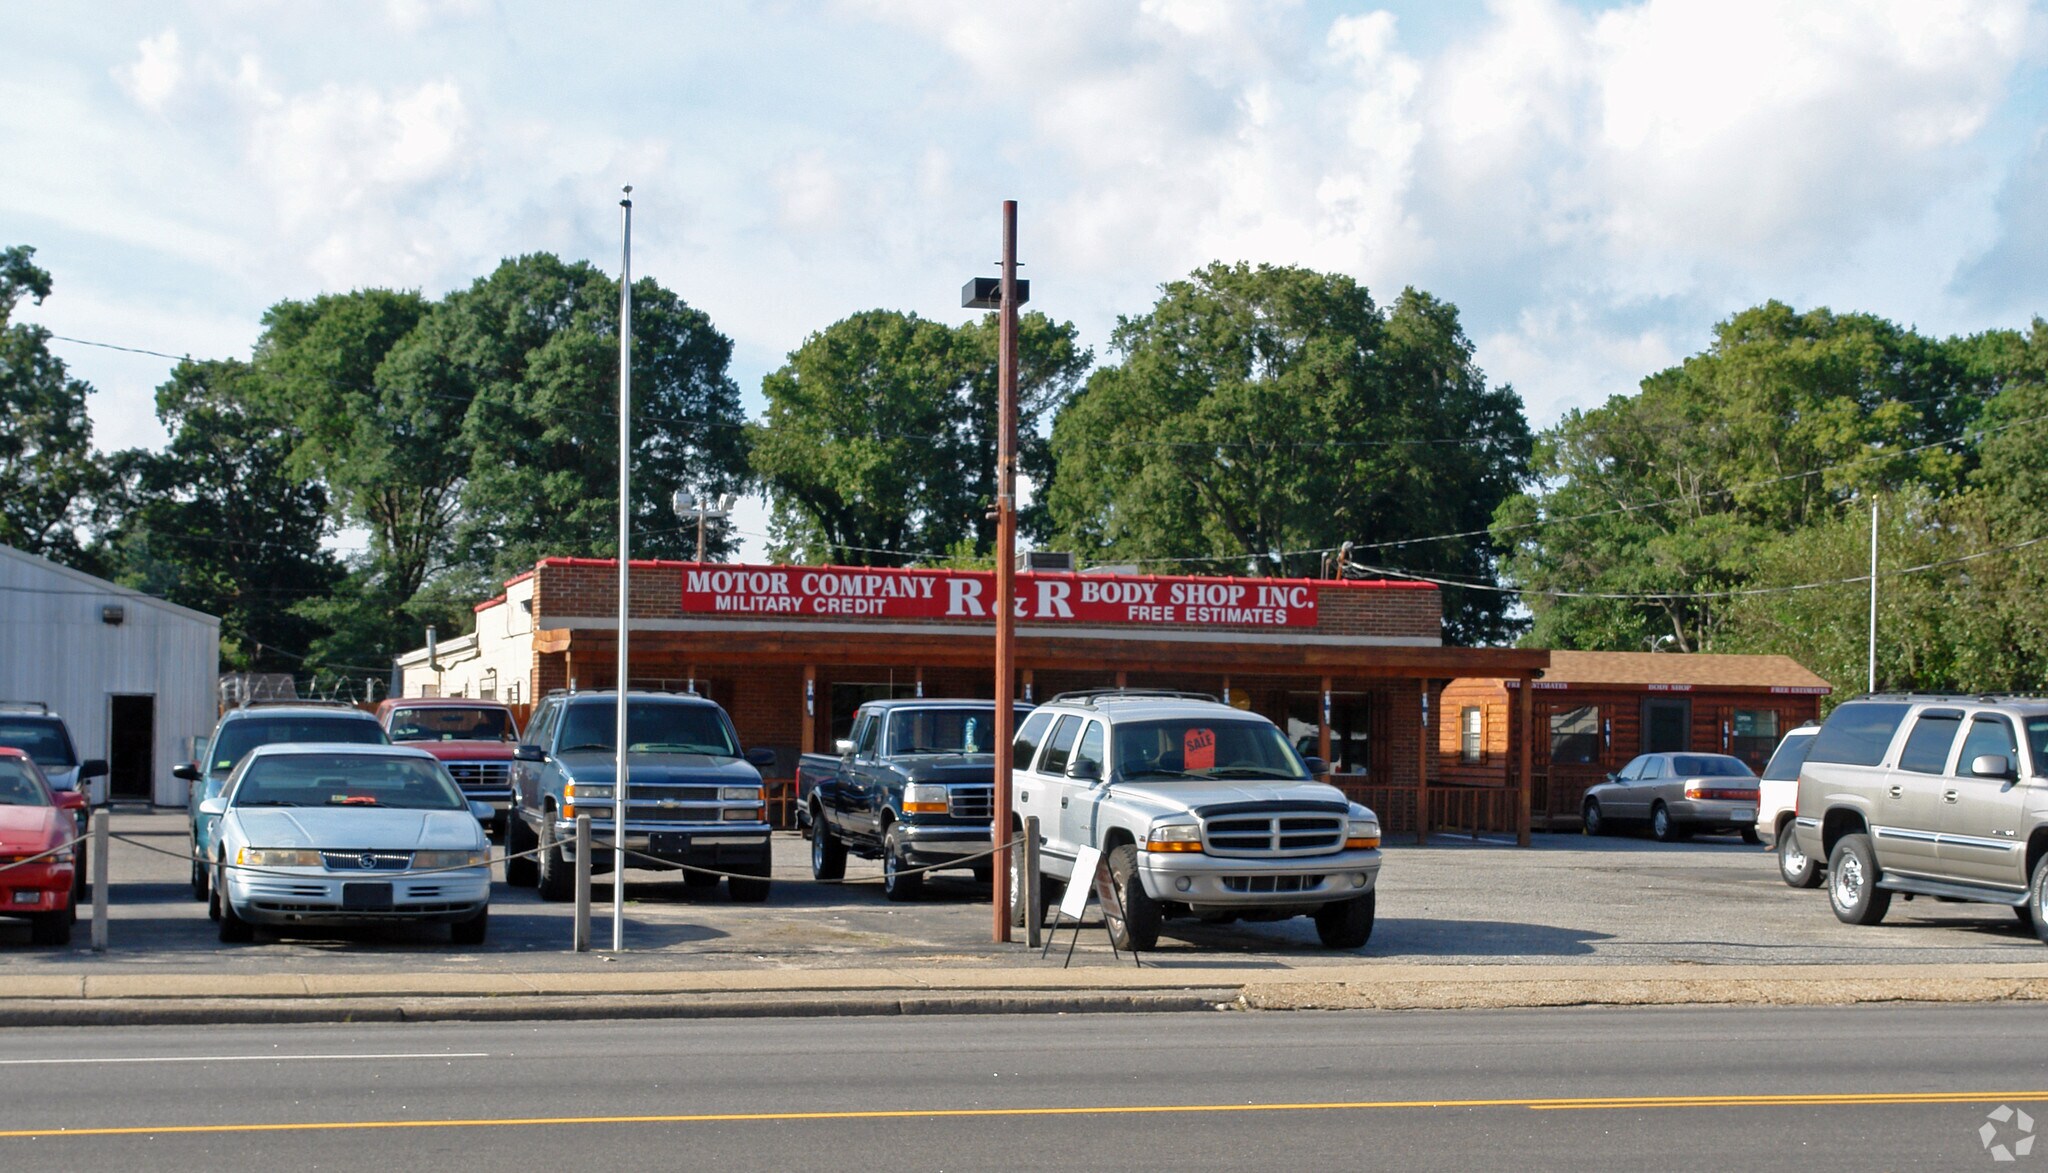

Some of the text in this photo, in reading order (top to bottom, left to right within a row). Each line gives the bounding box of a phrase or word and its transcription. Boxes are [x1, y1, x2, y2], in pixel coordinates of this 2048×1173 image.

[686, 570, 790, 595] MOTOR
[801, 573, 936, 599] COMPANY
[945, 578, 986, 616] R
[1034, 580, 1075, 618] R
[1080, 581, 1159, 604] BODY
[1169, 583, 1246, 606] SHOP
[1257, 586, 1314, 609] INC.
[715, 594, 887, 614] MILITARY CREDIT
[1128, 605, 1287, 624] FREE ESTIMATES
[1530, 681, 1568, 690] STIMATES
[1770, 686, 1790, 694] FREE
[1186, 734, 1213, 752] SALE
